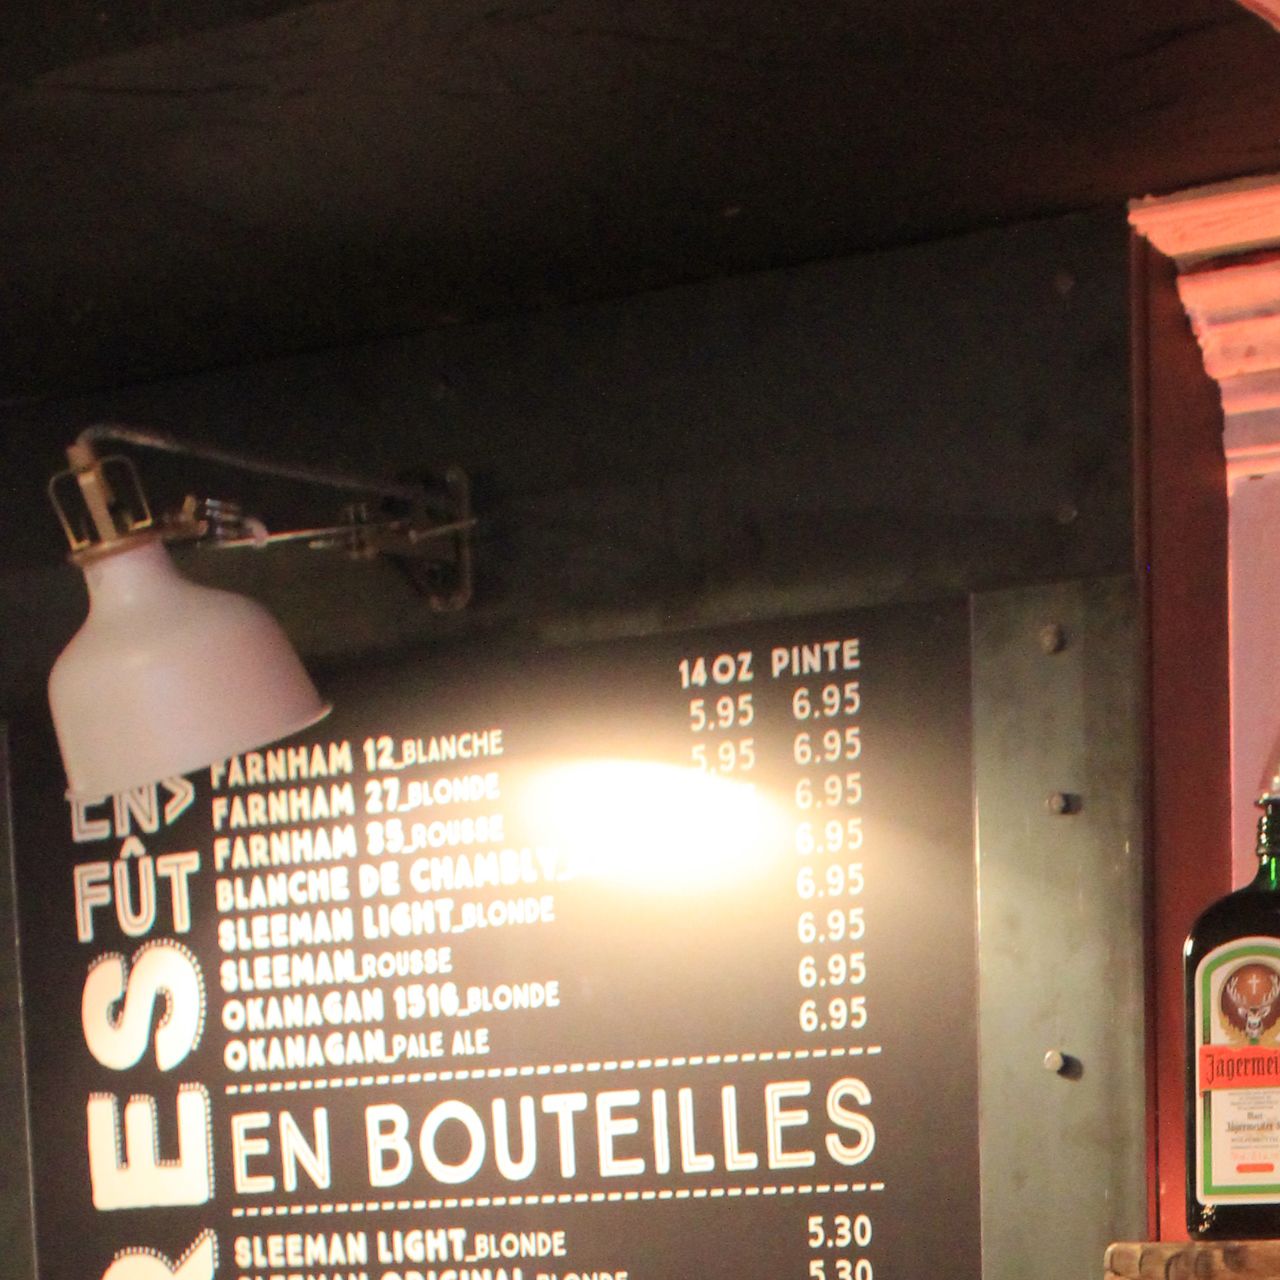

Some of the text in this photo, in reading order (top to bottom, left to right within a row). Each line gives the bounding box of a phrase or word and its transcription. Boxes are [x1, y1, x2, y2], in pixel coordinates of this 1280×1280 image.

[771, 639, 861, 678] PINTE
[689, 682, 861, 731] 5.95 6.95
[794, 727, 862, 766] 6.95
[212, 773, 862, 830] FARNHAM 6.95
[214, 825, 356, 871] FARNHAM
[74, 836, 199, 942] FÛT
[216, 862, 864, 912] BLANCHE DE 6.95
[218, 908, 353, 952] SLEEMAN
[798, 909, 865, 943] 6.95
[222, 989, 868, 1033] OKANAGAN 6.95
[231, 1078, 875, 1193] EN BOUTEILLES
[235, 1216, 872, 1268] SLEEMAN 5.30
